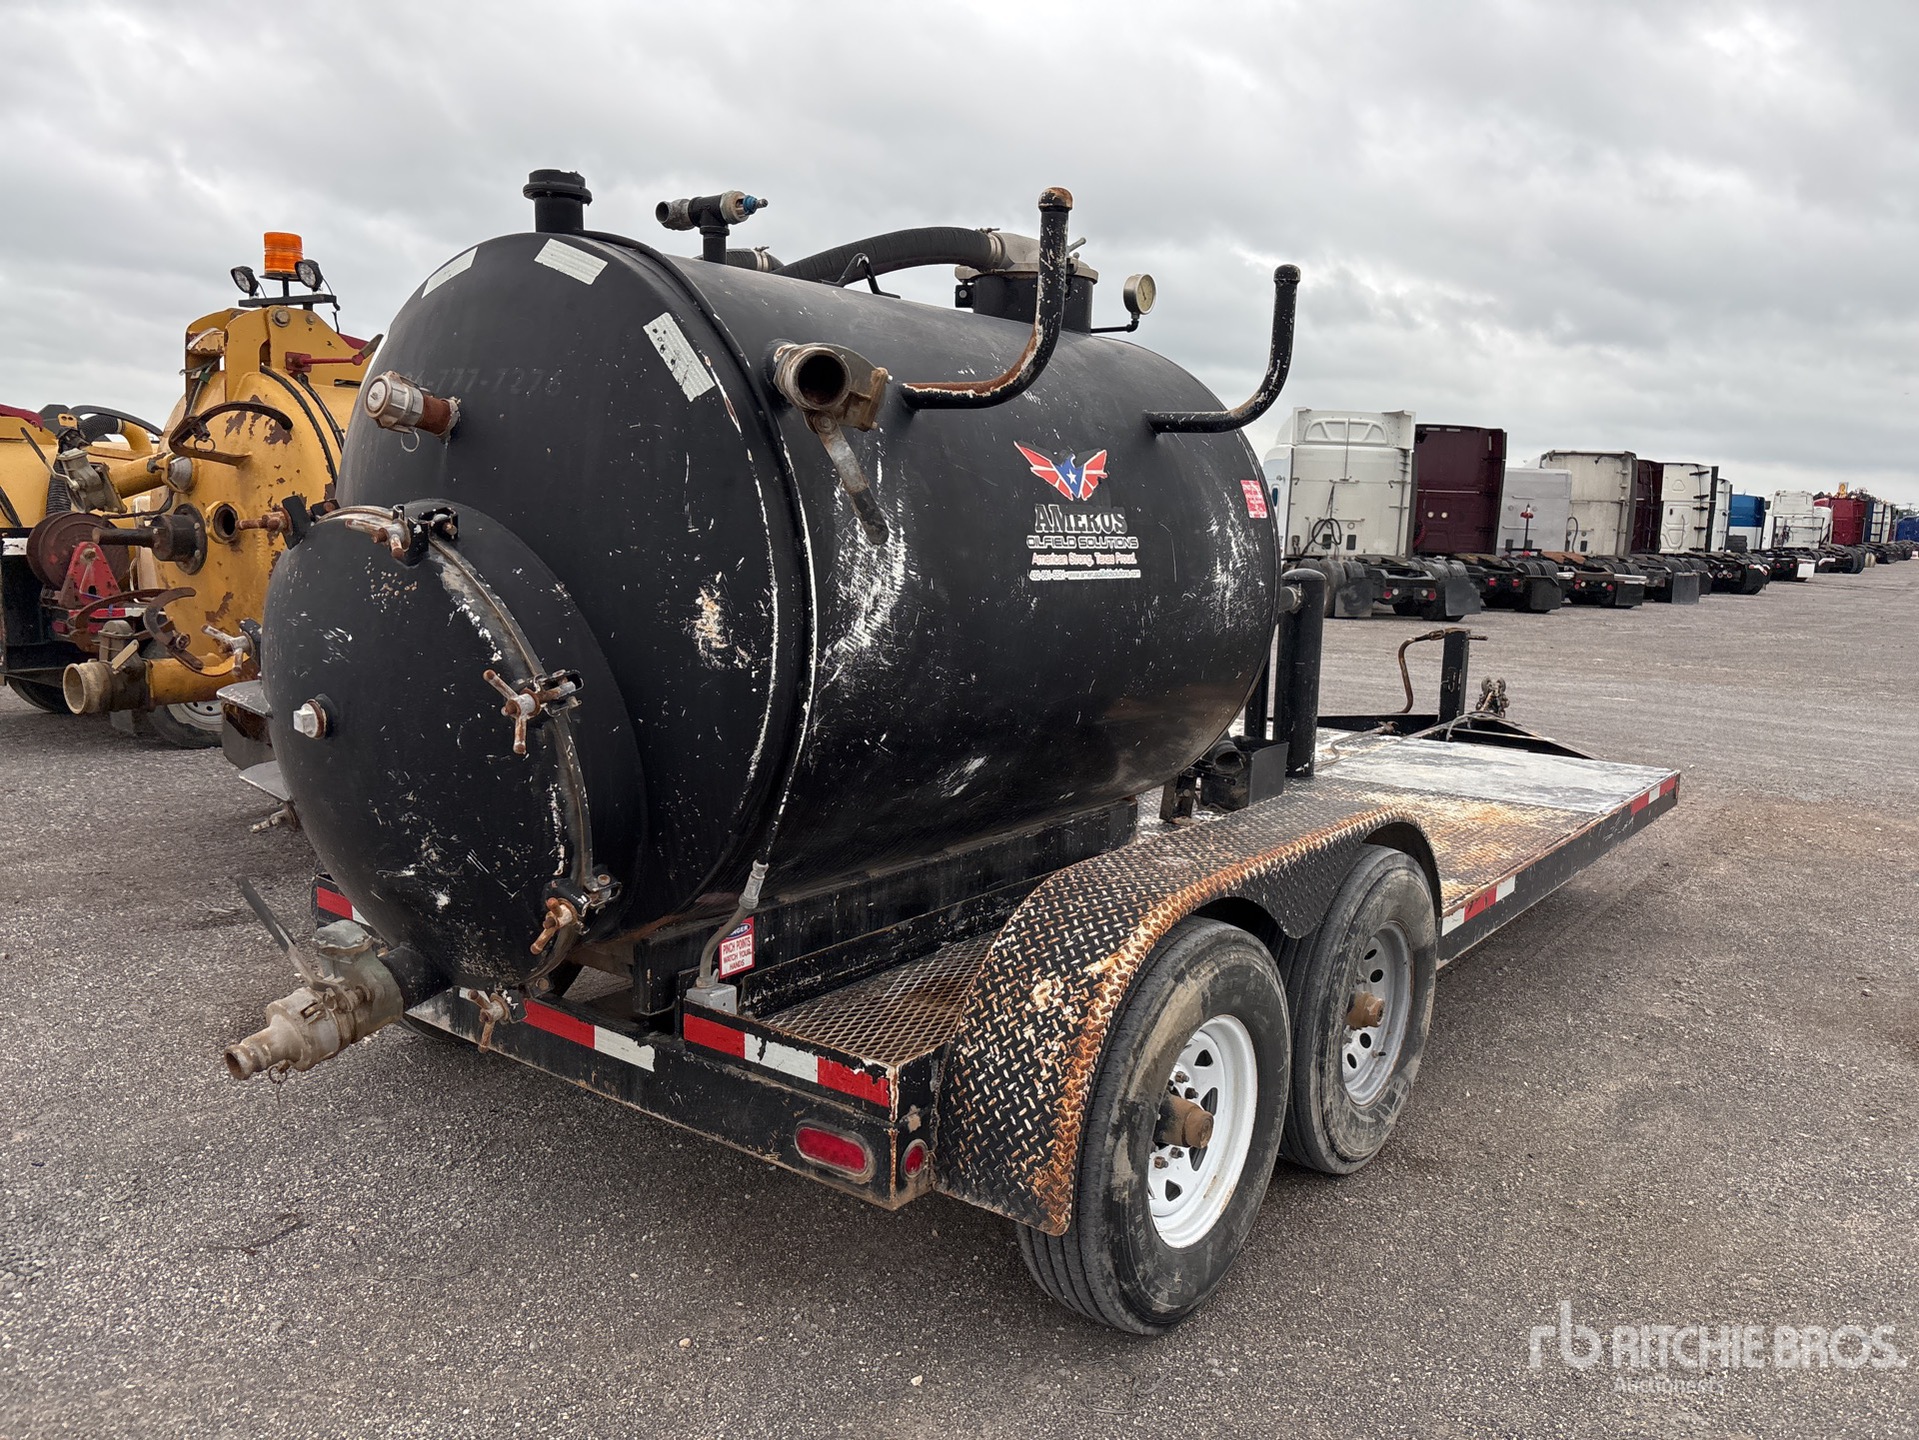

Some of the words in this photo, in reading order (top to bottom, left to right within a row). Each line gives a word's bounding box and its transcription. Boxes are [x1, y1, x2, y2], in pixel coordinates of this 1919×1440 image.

[1026, 535, 1077, 549] OILFIELD
[1078, 536, 1139, 549] SOLUTIONS
[1032, 552, 1068, 565] American
[1094, 552, 1115, 565] Texas
[723, 942, 735, 955] PINCH
[736, 936, 751, 950] POINTS
[723, 953, 738, 964] WATCH
[739, 949, 751, 958] YOUR
[730, 959, 745, 970] HANDS
